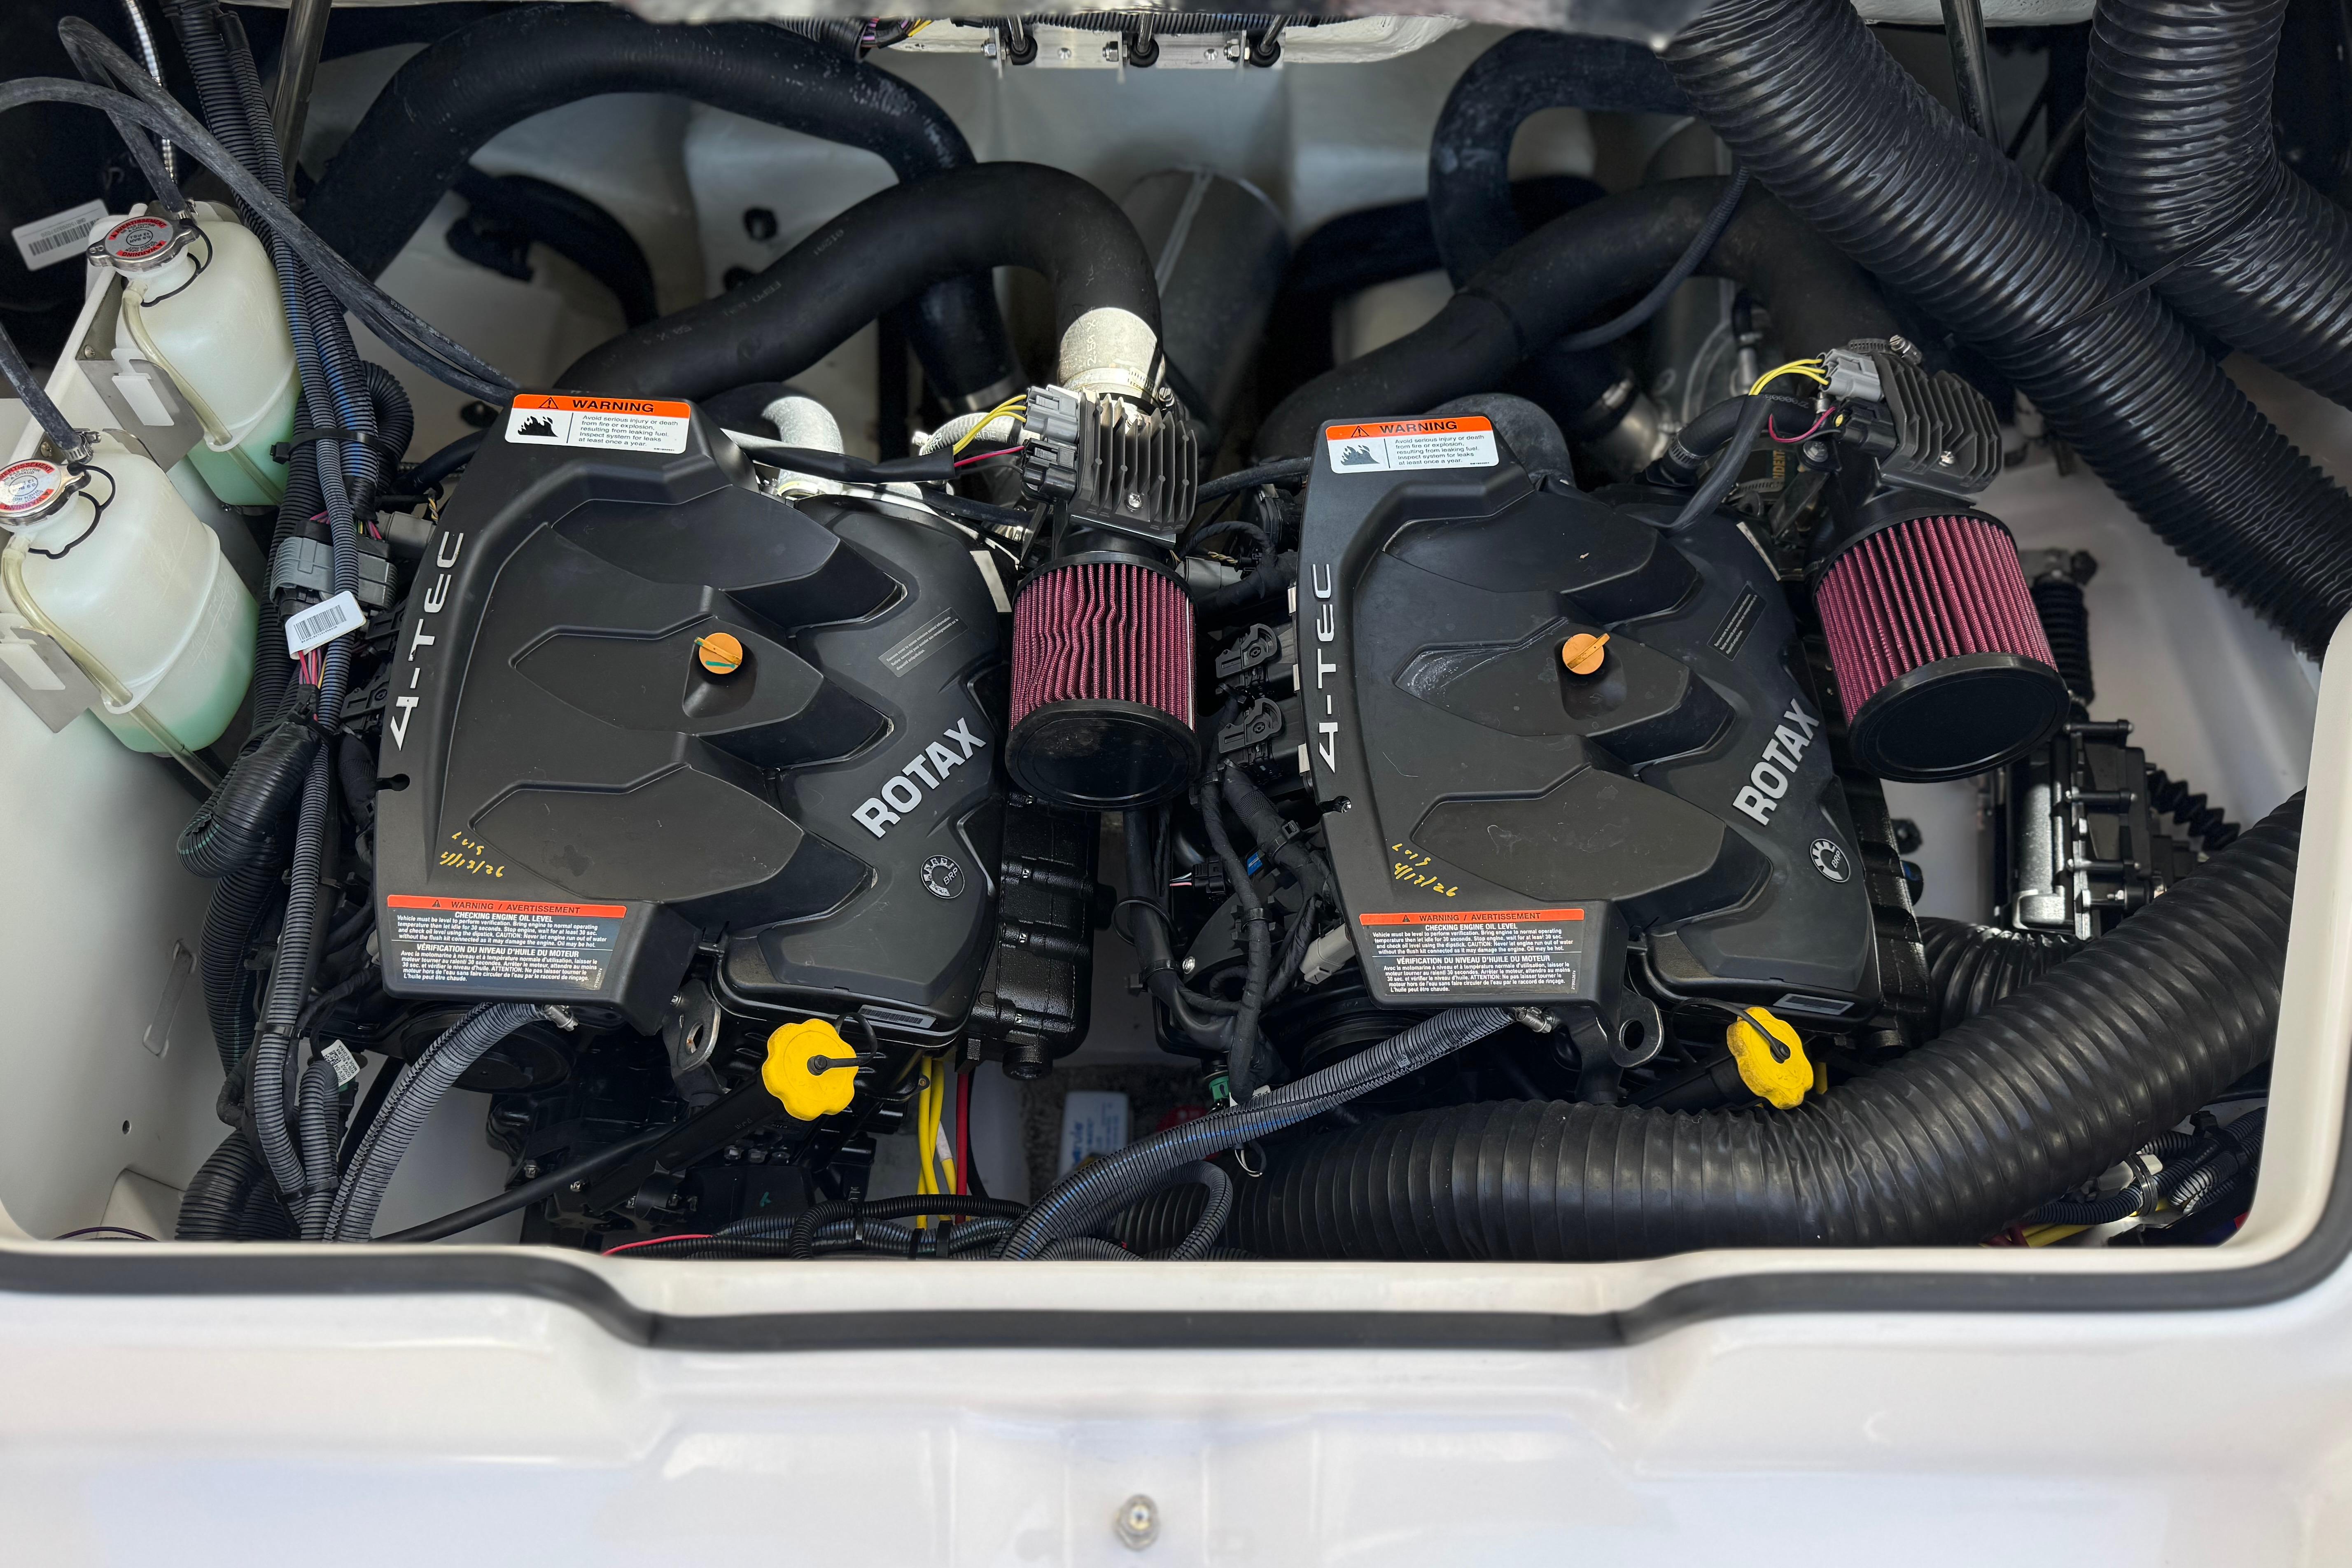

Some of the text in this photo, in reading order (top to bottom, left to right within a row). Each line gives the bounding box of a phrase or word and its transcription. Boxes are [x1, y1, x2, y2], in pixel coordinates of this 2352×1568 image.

[115, 219, 167, 233] AVERTISSEMENT
[122, 246, 158, 257] WARNING
[573, 399, 654, 413] WARNING
[1379, 421, 1457, 434] WARNING
[0, 462, 52, 479] VERTISSEMENT
[390, 531, 463, 751] 4-TEC
[1312, 564, 1338, 773] 4-TEC
[1733, 699, 1819, 827] ROTAX
[852, 717, 987, 839] ROTAX
[1831, 850, 1841, 869] BRP
[943, 866, 959, 886] BRP
[506, 904, 580, 913] AVERTISSEMENT
[338, 1071, 347, 1080] REV
